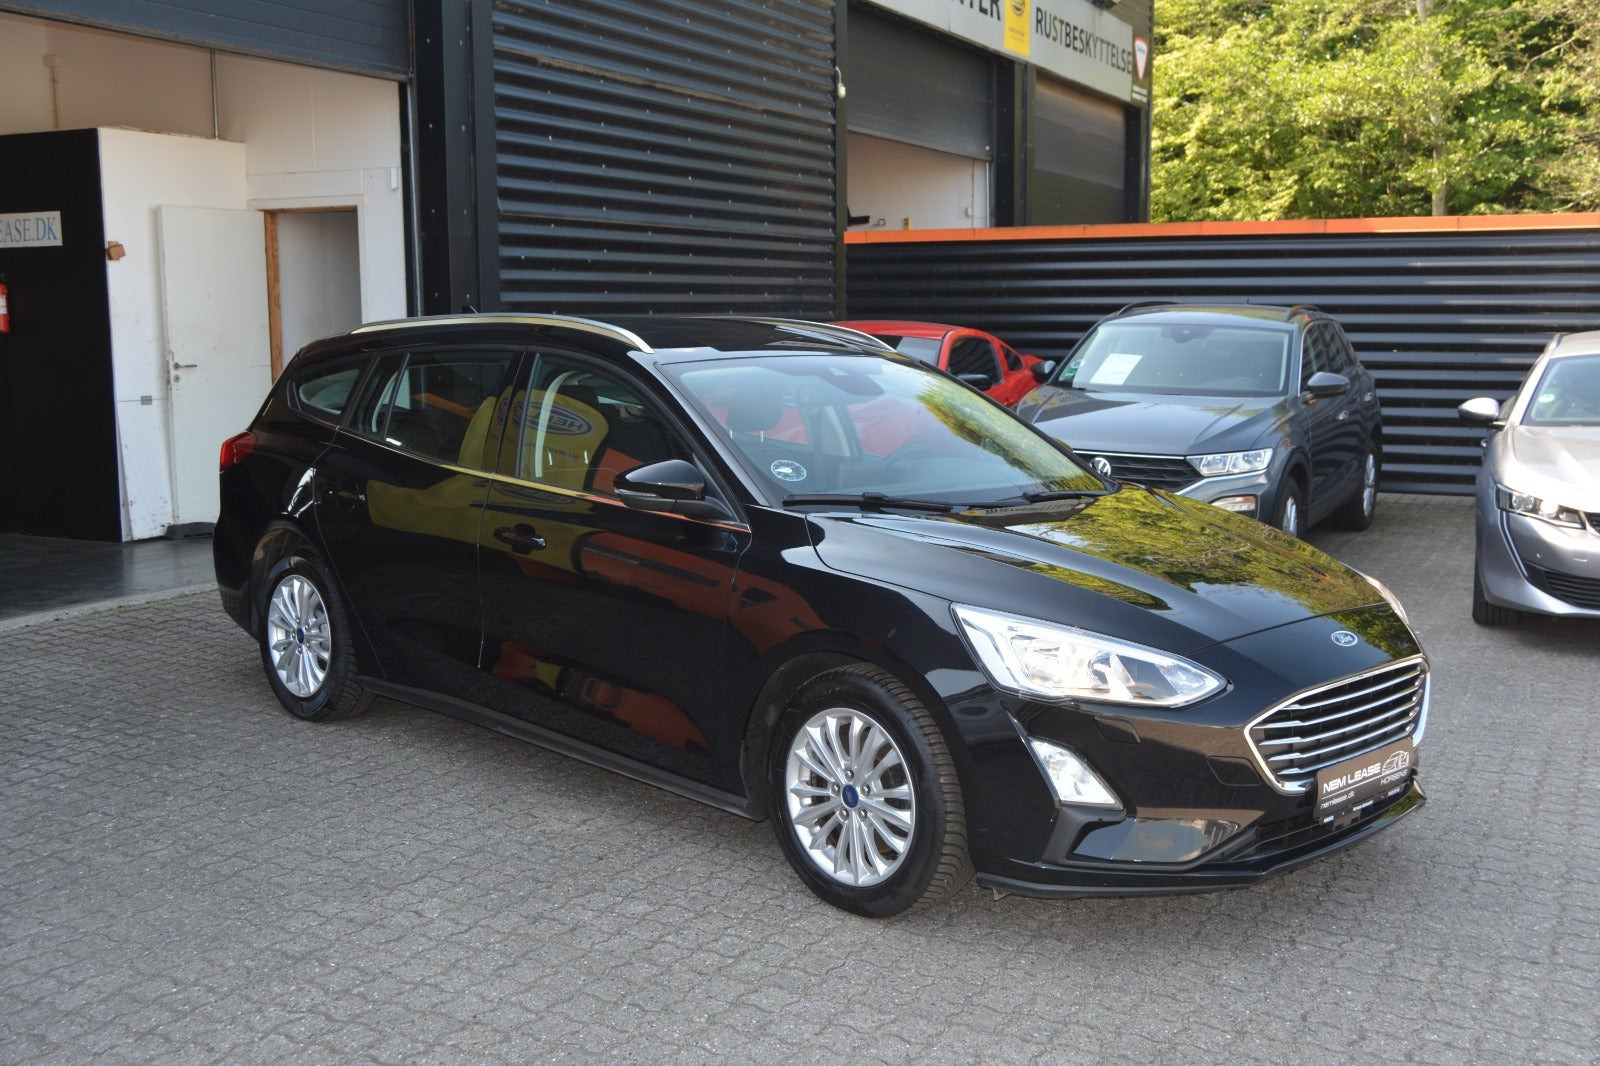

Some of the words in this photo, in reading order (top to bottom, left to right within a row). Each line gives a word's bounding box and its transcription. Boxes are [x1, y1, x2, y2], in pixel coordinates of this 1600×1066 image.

[1035, 6, 1133, 75] RUSTBESKYTTELSE
[1323, 775, 1347, 794] NEM
[1348, 763, 1381, 784] LEASE
